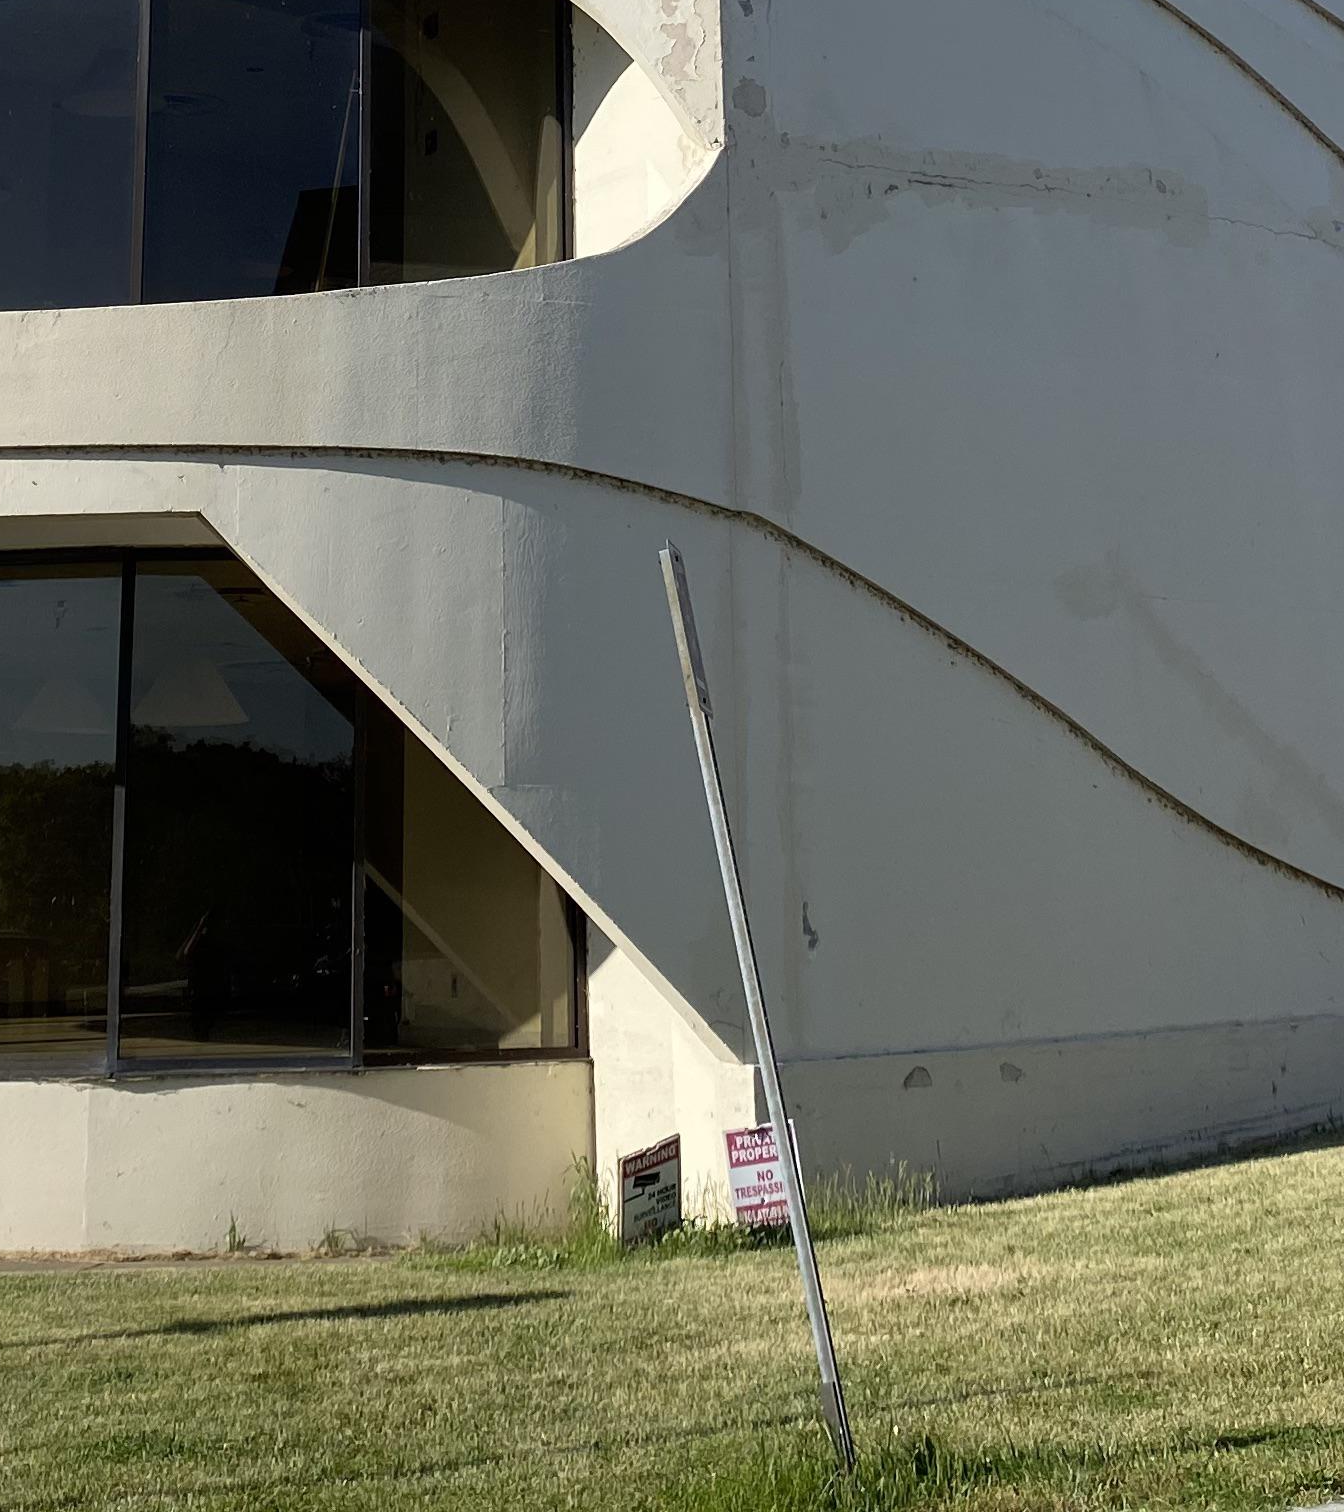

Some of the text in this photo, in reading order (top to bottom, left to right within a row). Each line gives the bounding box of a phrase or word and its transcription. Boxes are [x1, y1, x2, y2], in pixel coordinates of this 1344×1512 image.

[735, 1131, 775, 1149] PRIVAT
[625, 1143, 678, 1175] WARNING
[731, 1144, 778, 1164] PROPER
[756, 1169, 774, 1182] NO
[734, 1181, 784, 1200] TRESPASSI
